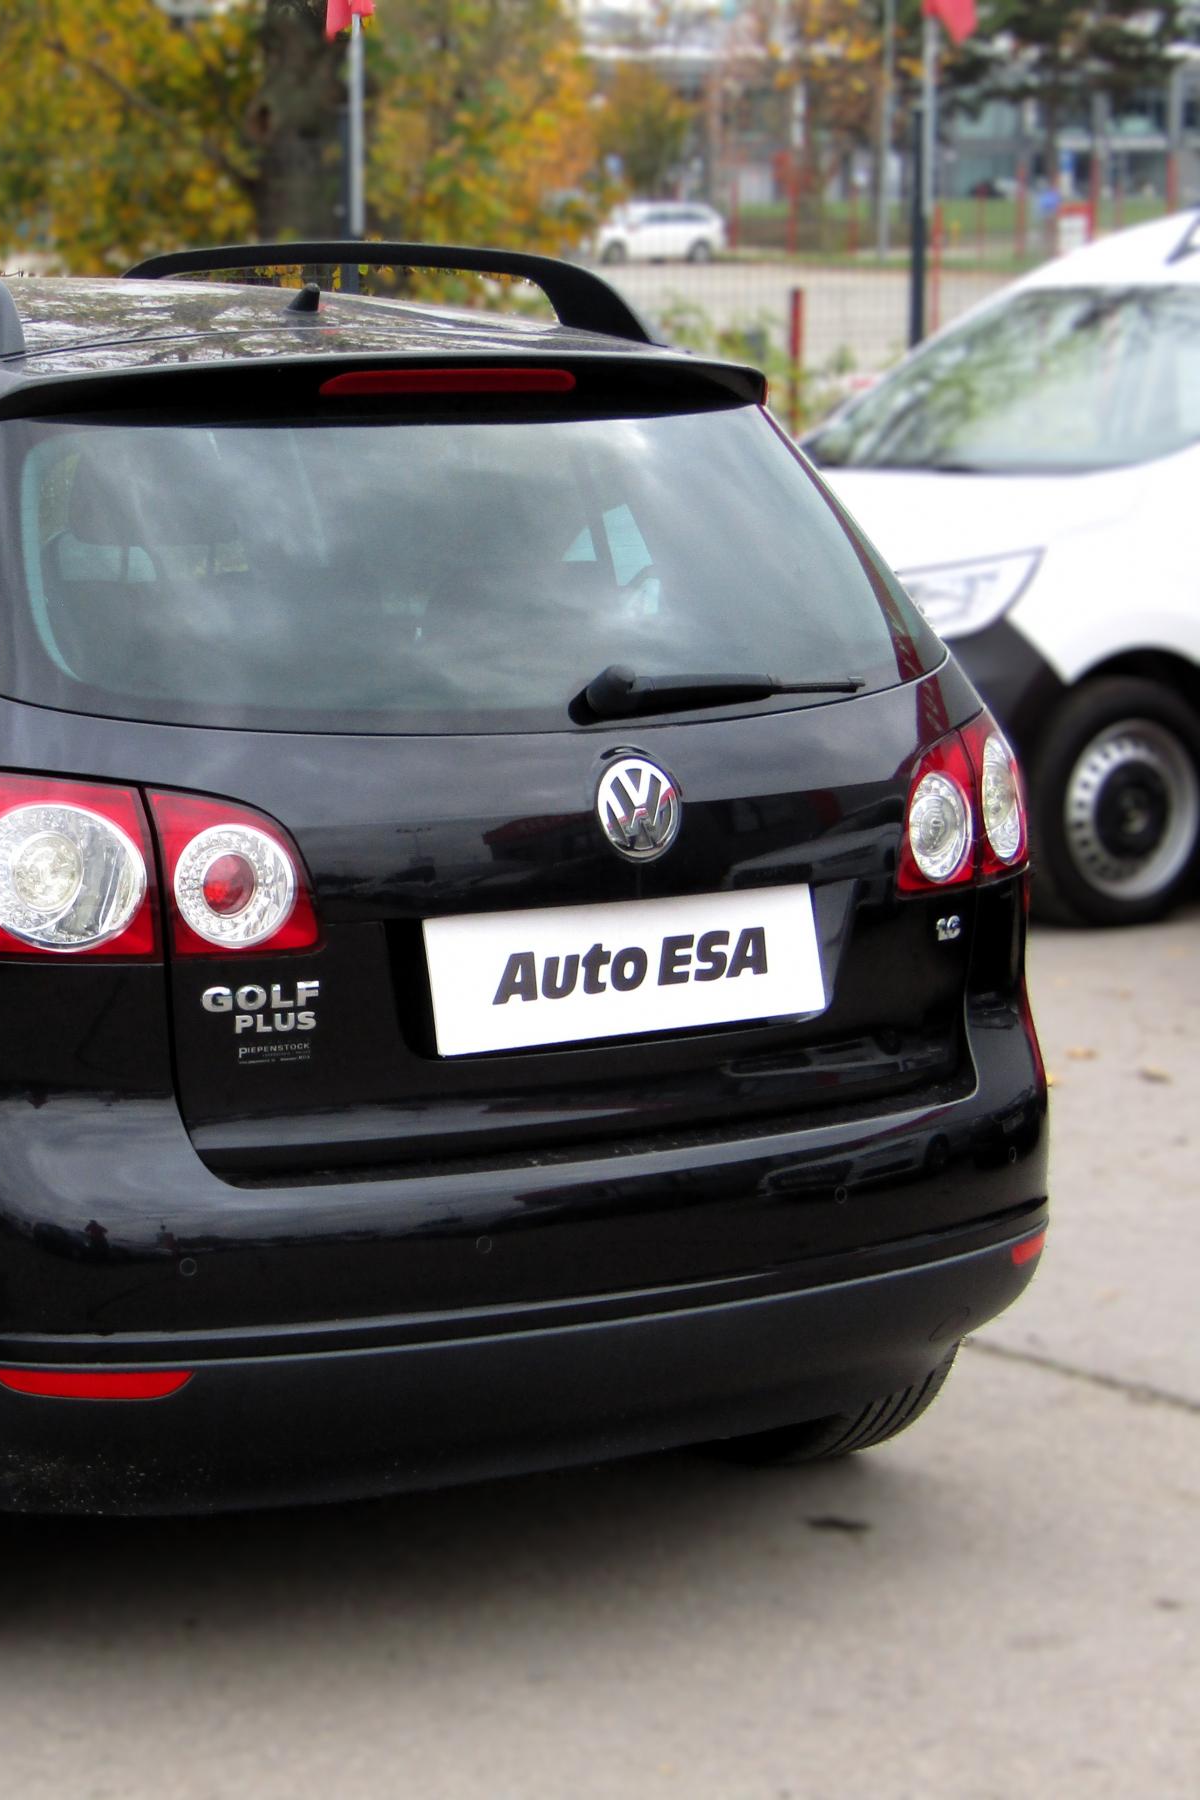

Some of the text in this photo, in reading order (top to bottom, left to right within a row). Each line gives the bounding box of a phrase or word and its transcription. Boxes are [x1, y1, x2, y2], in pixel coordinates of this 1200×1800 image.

[492, 926, 769, 1006] Auto ESA
[202, 981, 319, 1012] GOLF
[235, 1011, 317, 1034] PLUS
